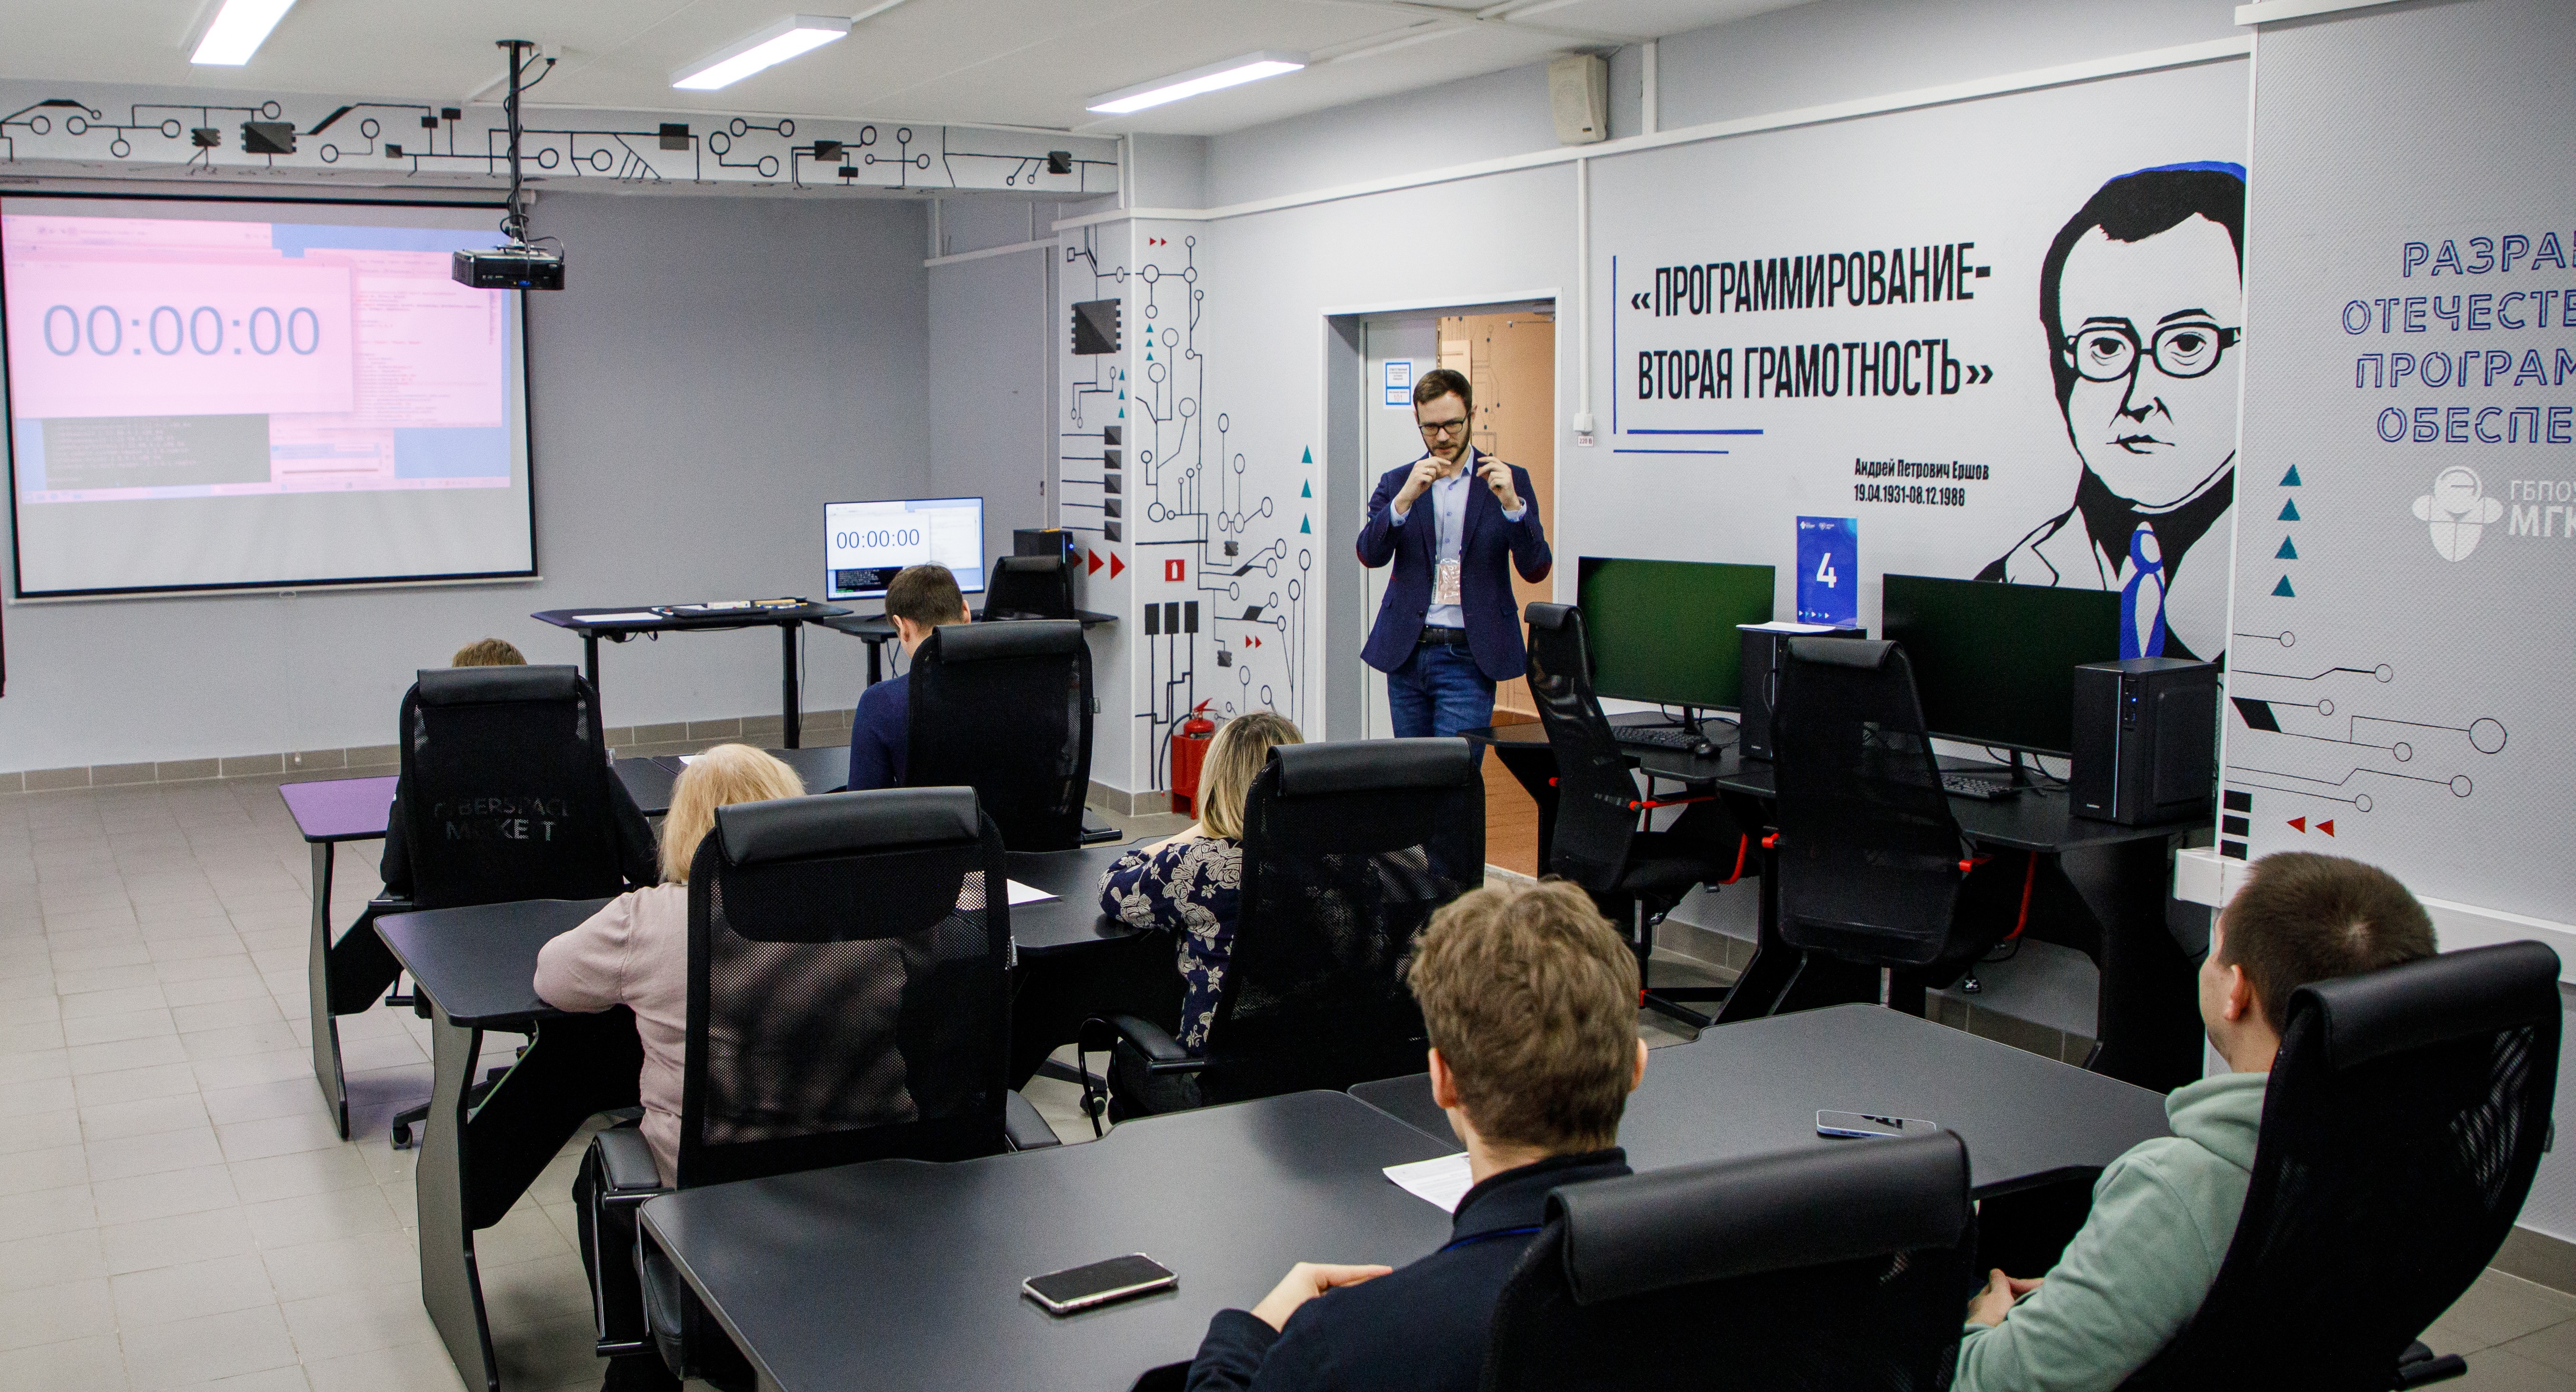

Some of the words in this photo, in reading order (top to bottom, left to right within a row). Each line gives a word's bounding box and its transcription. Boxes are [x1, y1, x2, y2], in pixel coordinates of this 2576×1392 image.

[2403, 230, 2576, 277] РАЗРА
[1631, 242, 1991, 317] «ПРОГРАММИРОВАНИЕ-
[43, 305, 320, 356] 00:00:00
[1639, 348, 1733, 400] ВТОРАЯ
[1744, 339, 1994, 398] ГРАМОТНОСТЬ»
[2377, 406, 2573, 444] ОБЕСПЕ
[1855, 458, 1895, 478] Андрей
[1897, 459, 1950, 479] Петрович
[1952, 460, 1990, 481] Ершов
[1854, 483, 1966, 507] 19.04.1931-08.12.1988
[2510, 480, 2576, 502] ГБПО
[836, 529, 919, 549] 00:00:00
[1816, 552, 1837, 588] 4
